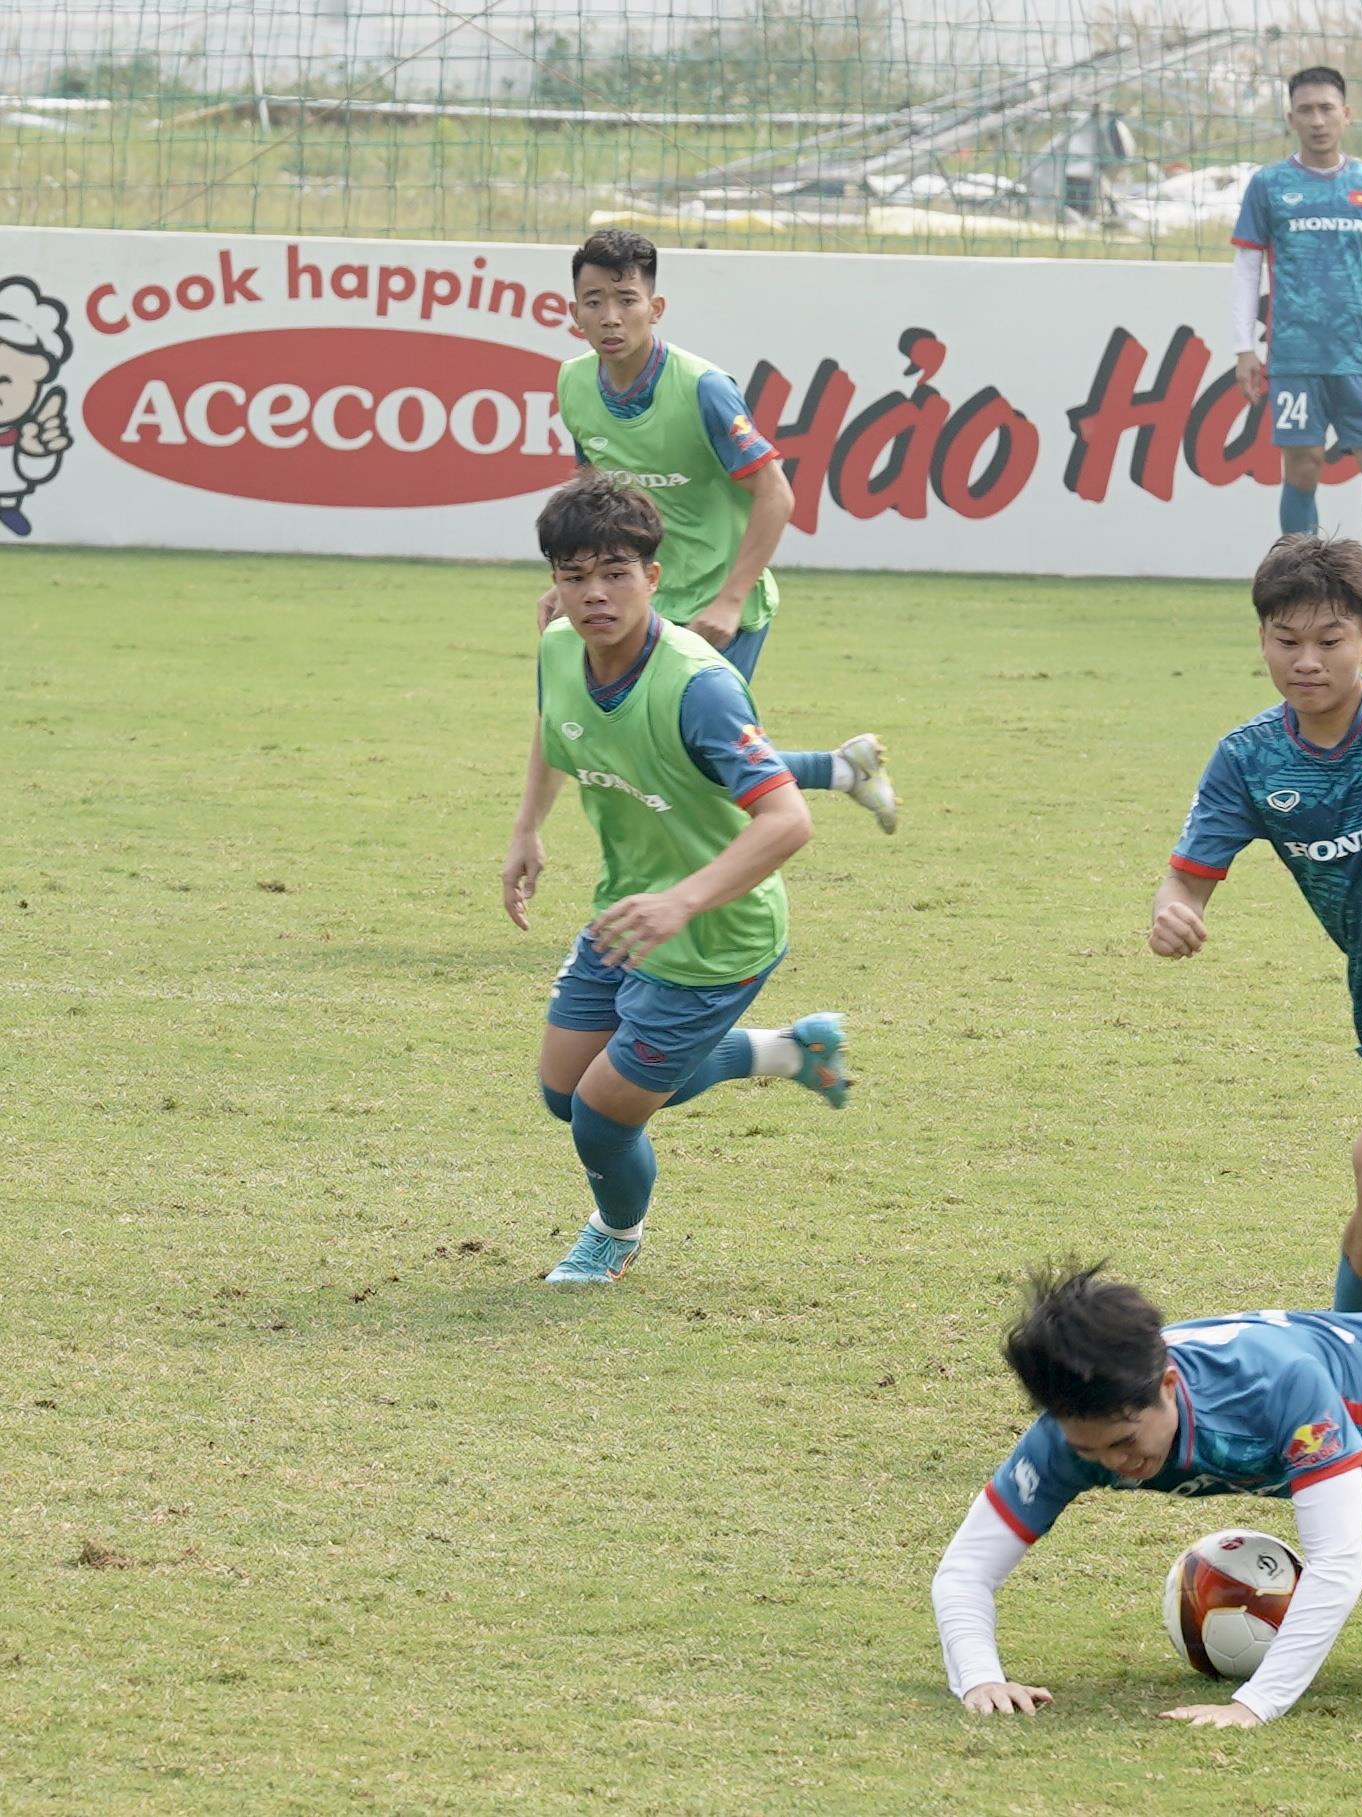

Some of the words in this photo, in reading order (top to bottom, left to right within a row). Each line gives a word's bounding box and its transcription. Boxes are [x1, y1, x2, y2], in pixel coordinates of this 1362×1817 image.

[86, 249, 262, 335] Cook
[286, 245, 588, 340] happine
[744, 326, 1040, 535] Hảo
[1276, 390, 1308, 430] 24
